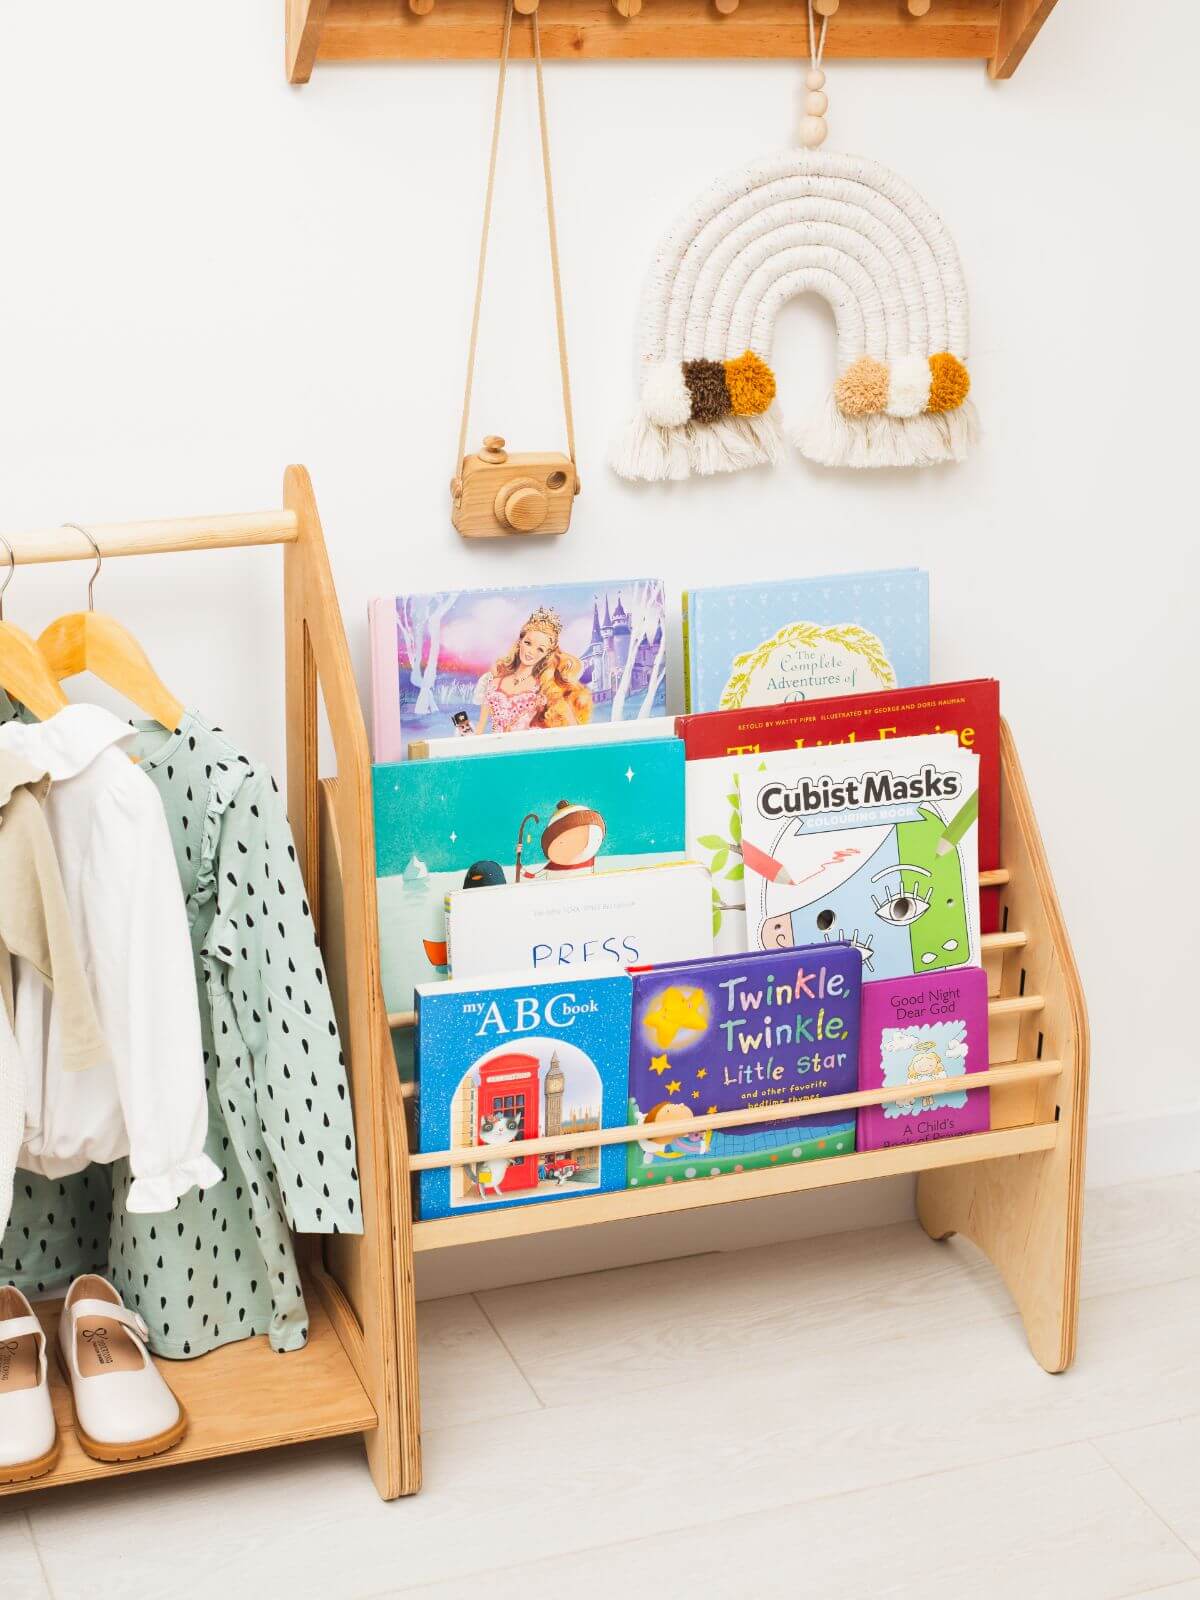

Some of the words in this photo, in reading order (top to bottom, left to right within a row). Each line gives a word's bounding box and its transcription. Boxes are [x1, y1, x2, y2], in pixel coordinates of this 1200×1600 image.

[780, 653, 842, 675] Complete
[796, 651, 815, 660] The
[767, 674, 840, 690] Adventures
[844, 667, 858, 687] of
[738, 722, 763, 731] RETOLD
[775, 719, 797, 727] WATTY
[820, 710, 862, 721] ILLUSTRATED
[874, 705, 899, 714] GEORGE
[901, 703, 915, 711] AND
[917, 701, 936, 709] DORIS
[761, 780, 859, 815] Cubist
[863, 769, 958, 804] Masks
[719, 966, 850, 1011] Twinkle,
[890, 992, 924, 1008] Good
[928, 987, 961, 1003] Night
[463, 1002, 485, 1015] my
[475, 993, 576, 1036] ABC
[562, 1000, 599, 1015] book
[896, 1008, 926, 1020] Dear
[930, 1001, 956, 1015] God
[719, 1008, 848, 1054] Twinkle,
[723, 1056, 785, 1086] Little
[741, 1090, 758, 1099] and
[761, 1087, 786, 1096] other
[790, 1081, 827, 1093] favorite
[903, 1124, 913, 1137] A
[917, 1118, 955, 1134] Child's
